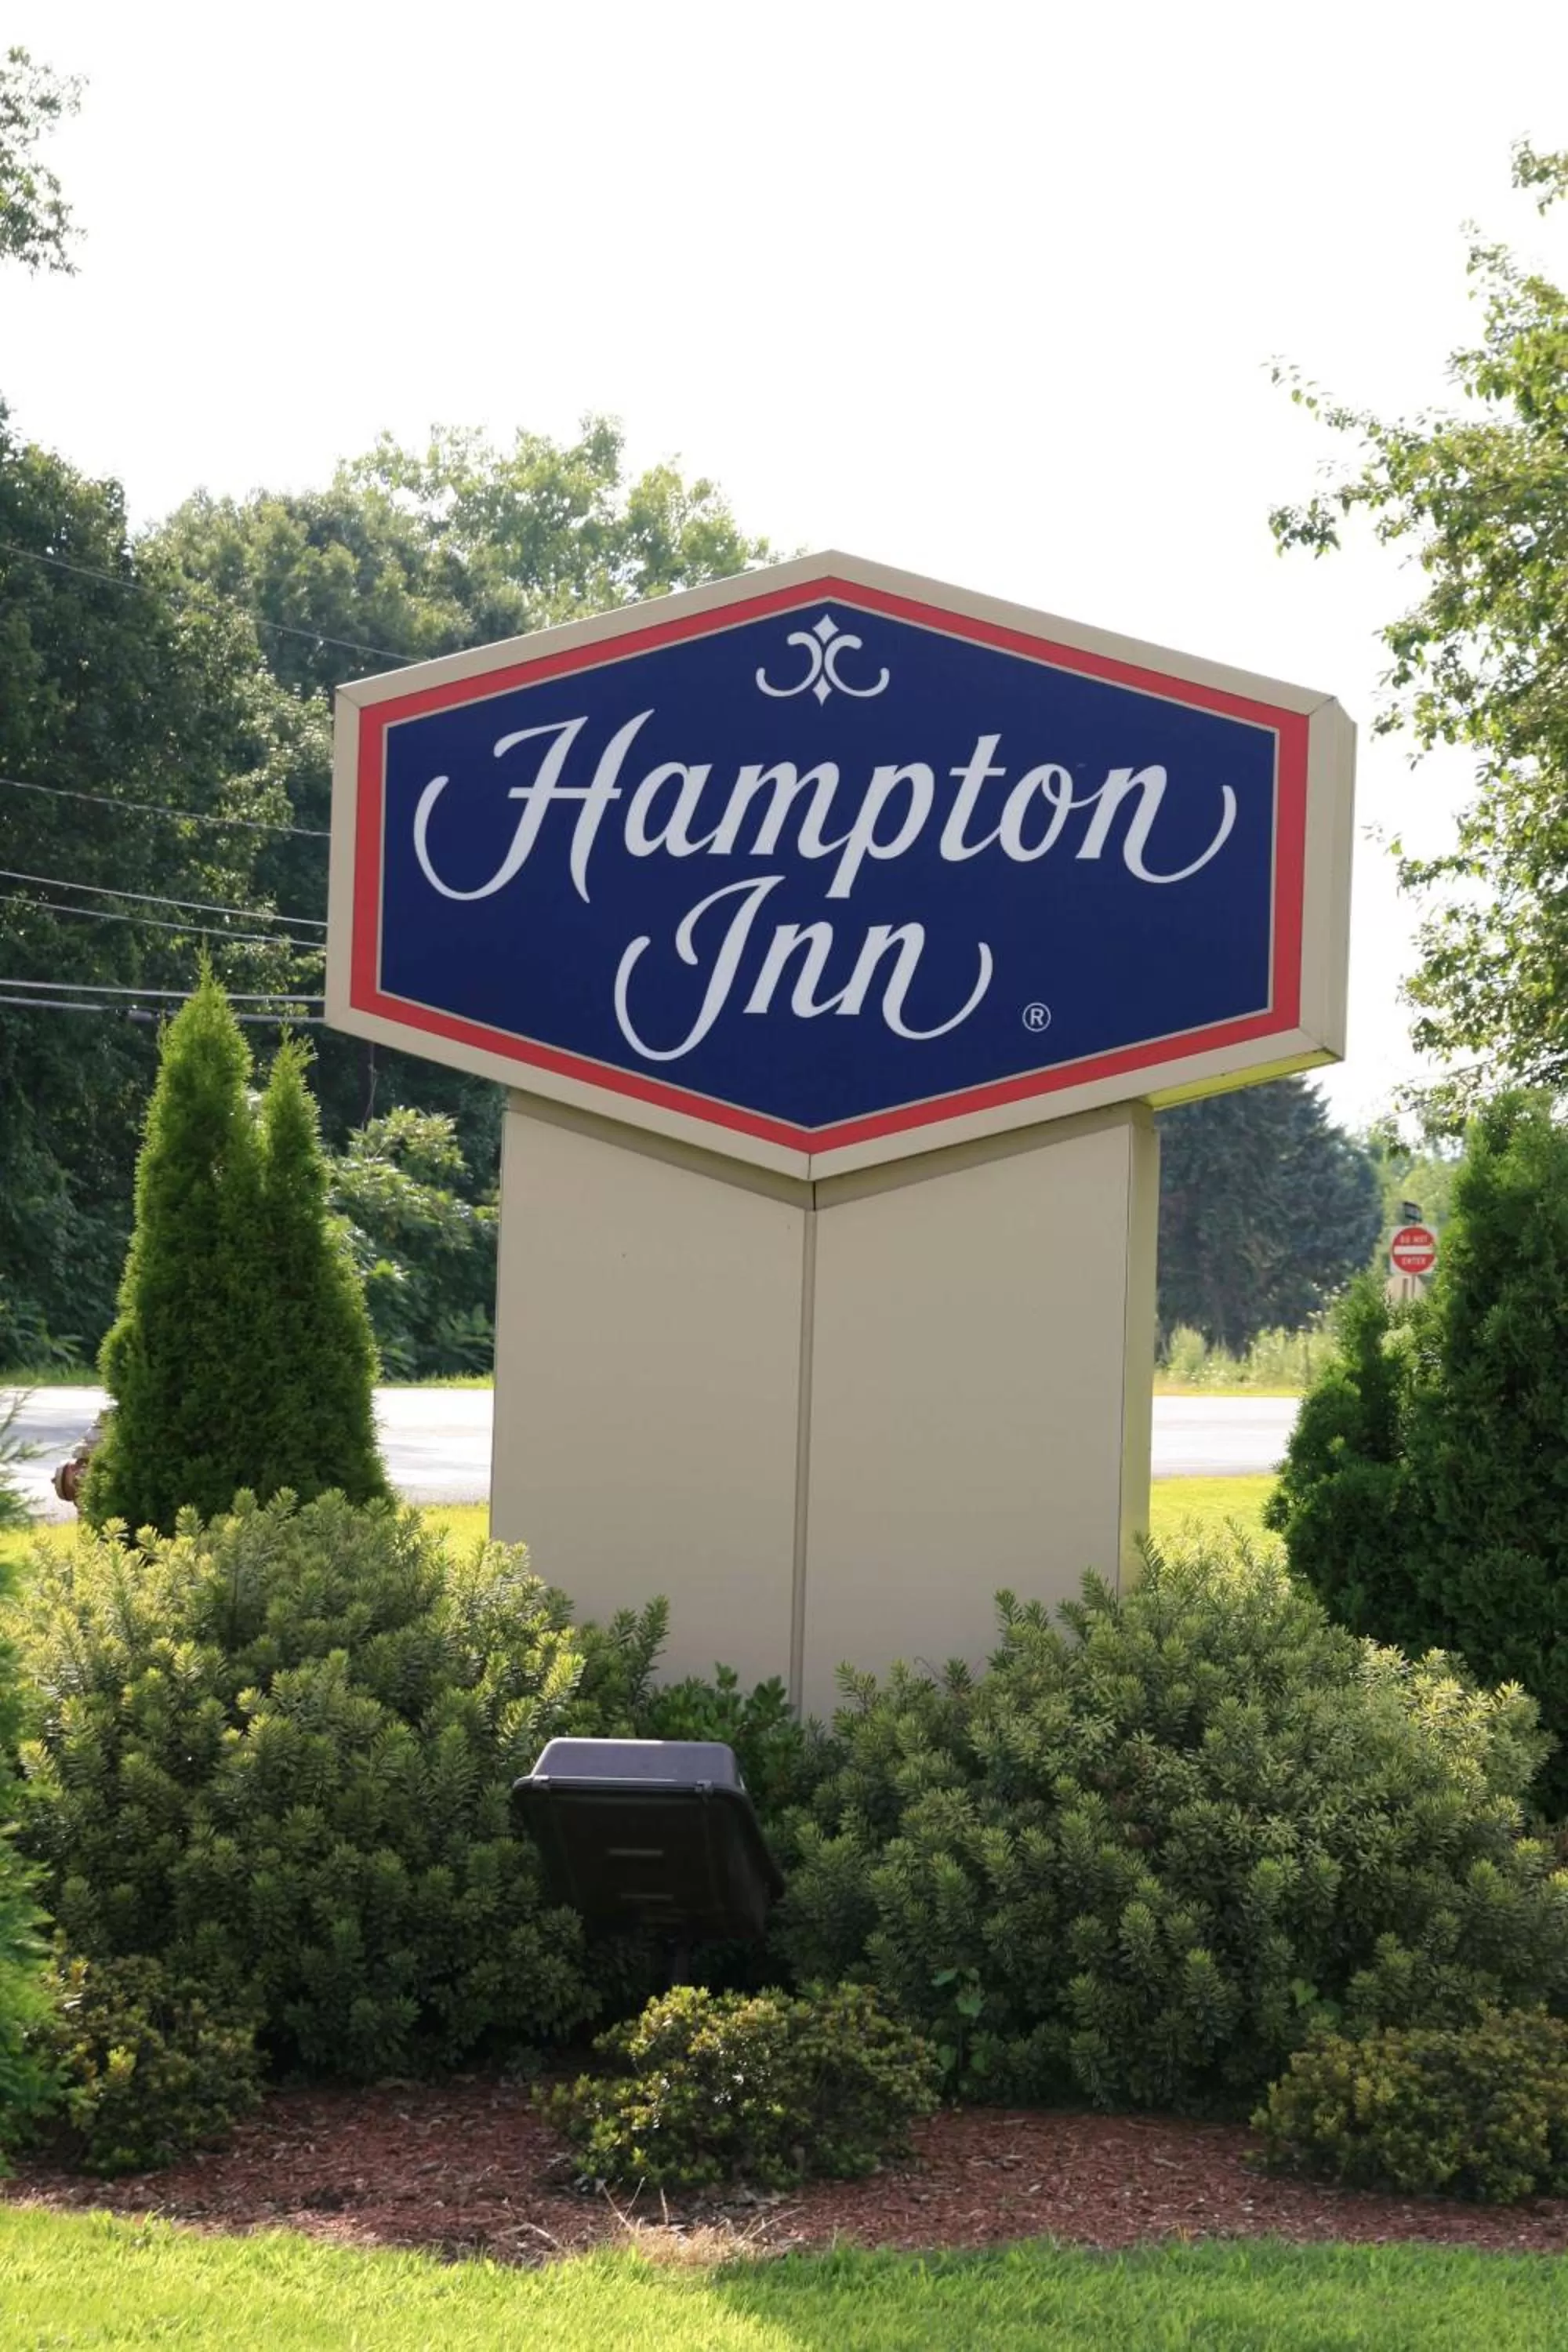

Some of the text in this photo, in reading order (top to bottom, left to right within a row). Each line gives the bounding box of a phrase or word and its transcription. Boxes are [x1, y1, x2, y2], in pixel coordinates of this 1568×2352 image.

[413, 707, 1237, 902] Hampton
[614, 875, 993, 1061] Inn
[1400, 1256, 1426, 1265] ENTER
